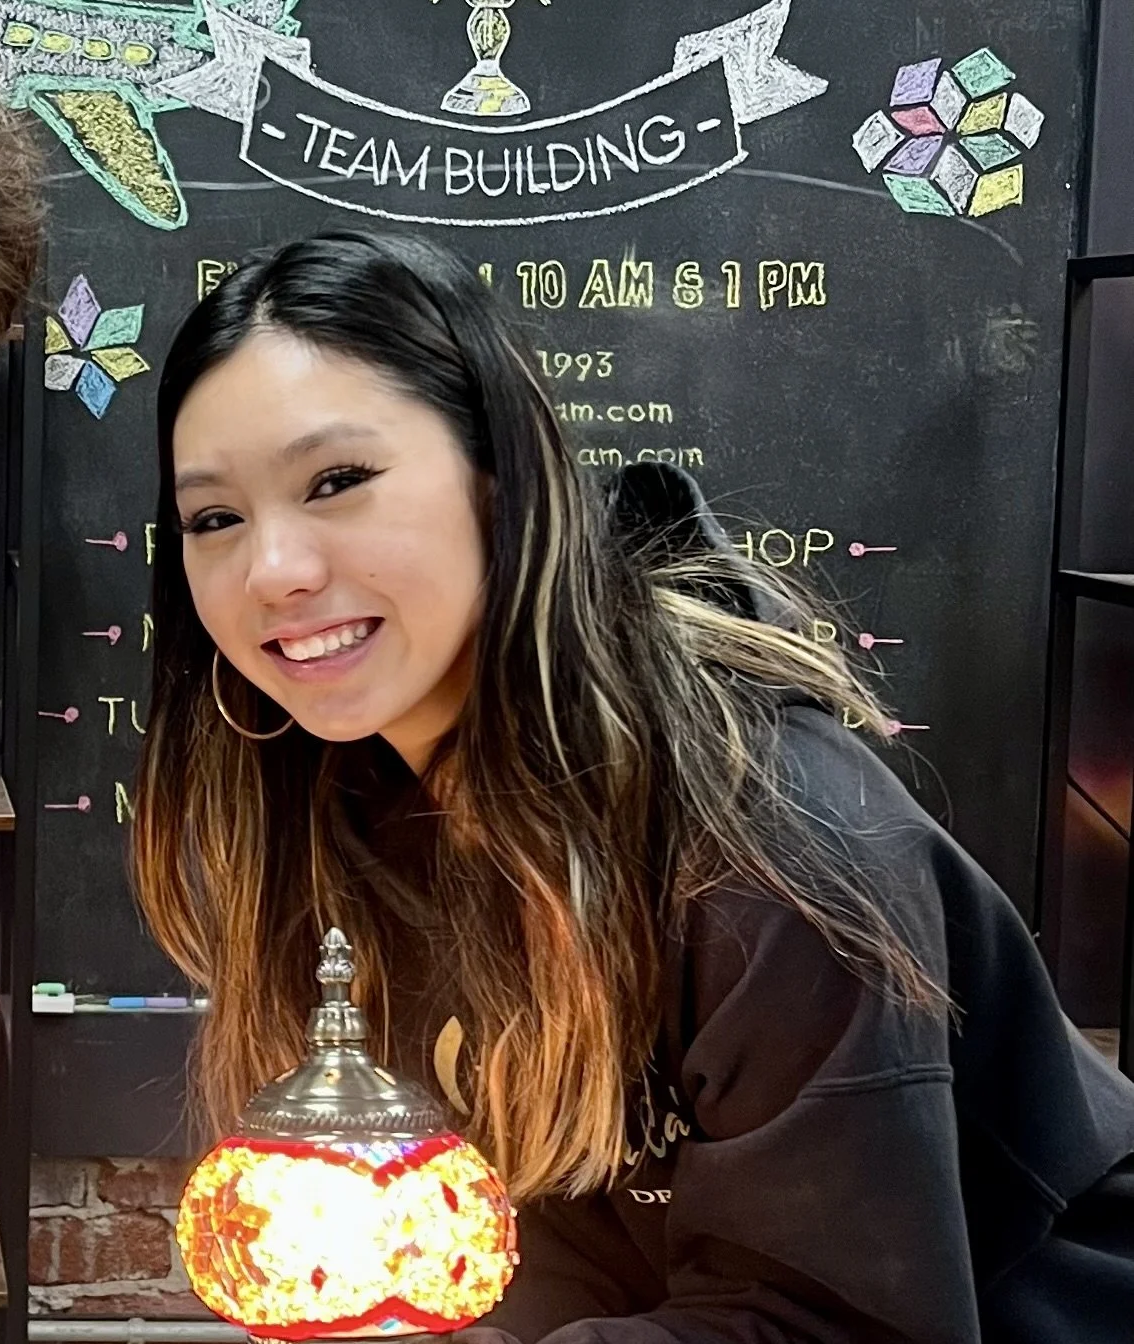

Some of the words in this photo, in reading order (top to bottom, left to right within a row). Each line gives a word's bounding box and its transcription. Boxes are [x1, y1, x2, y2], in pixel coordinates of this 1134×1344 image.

[296, 112, 430, 191] TEAM
[445, 114, 686, 197] BUILDING
[517, 259, 566, 309] 10
[579, 258, 654, 309] AM
[721, 260, 742, 309] 1
[758, 259, 827, 311] PM
